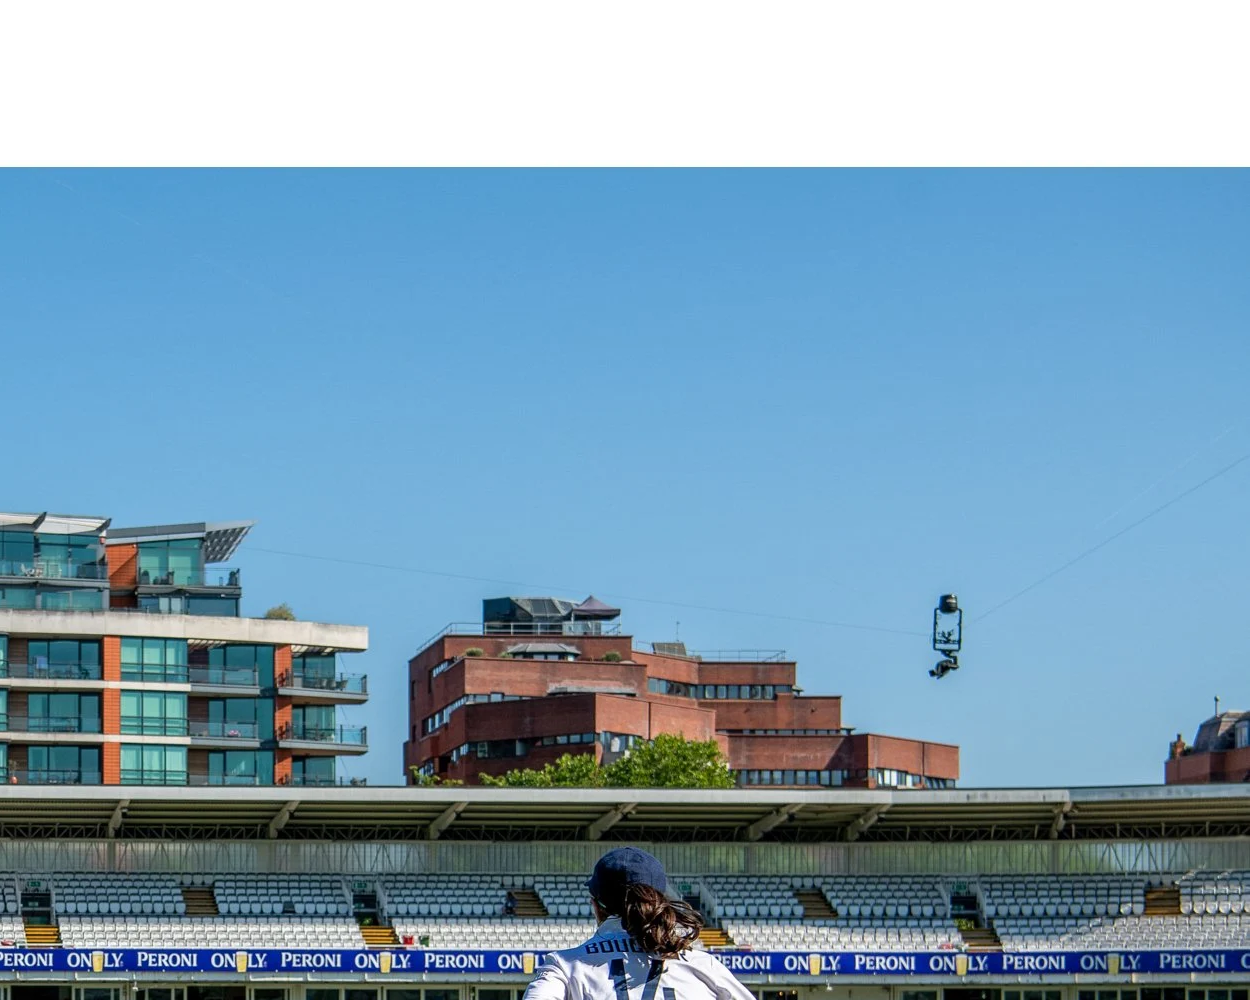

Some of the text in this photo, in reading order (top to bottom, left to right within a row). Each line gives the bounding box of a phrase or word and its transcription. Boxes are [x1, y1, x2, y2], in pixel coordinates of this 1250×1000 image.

[137, 952, 197, 967] PERONI
[281, 952, 341, 967] PERONI
[424, 953, 484, 968] PERONI
[855, 954, 915, 970] PERONI
[1002, 956, 1066, 970] PERONI
[1160, 954, 1226, 969] PERONI
